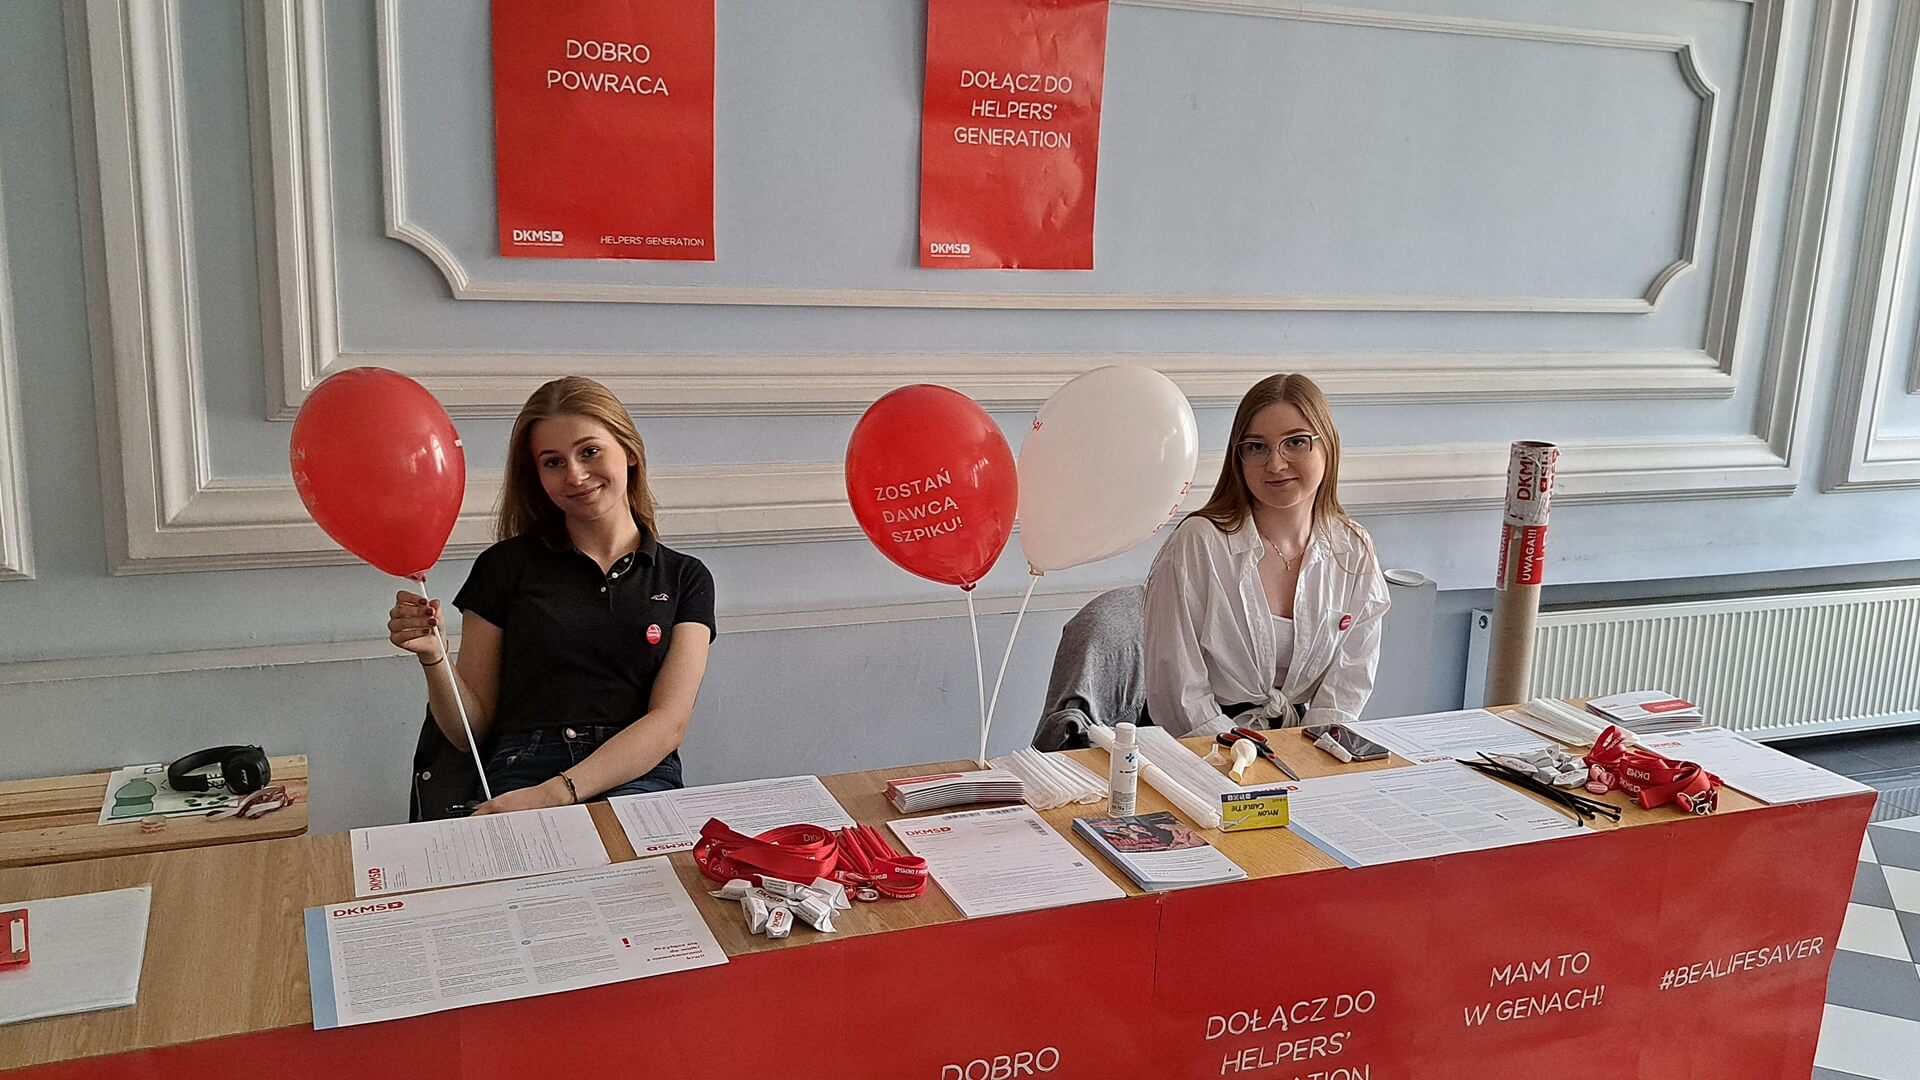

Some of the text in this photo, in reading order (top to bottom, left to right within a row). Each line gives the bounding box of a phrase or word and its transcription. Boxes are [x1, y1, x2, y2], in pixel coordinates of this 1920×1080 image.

[566, 39, 651, 64] DOBRO
[547, 69, 669, 96] POWRACA
[960, 69, 1073, 94] DOŁĄCZ DO
[953, 126, 1071, 149] GENERATION
[512, 229, 552, 242] DKMS
[645, 237, 705, 247] GENERATION
[930, 243, 961, 253] DKMS
[873, 467, 953, 501] ZOSTAŃ
[882, 496, 960, 523] DAWCĄ
[891, 516, 964, 543] SZPIKU!
[1257, 809, 1279, 817] NYLON
[905, 828, 942, 837] DKMS
[333, 902, 387, 918] DKMS
[1489, 951, 1590, 988] MAM TO
[1658, 936, 1824, 991] #BEALIFESAVER
[1205, 990, 1376, 1040] DOŁĄCZ DO
[1464, 984, 1605, 1027] W GENACH!
[941, 1046, 1060, 1080] DOBRO
